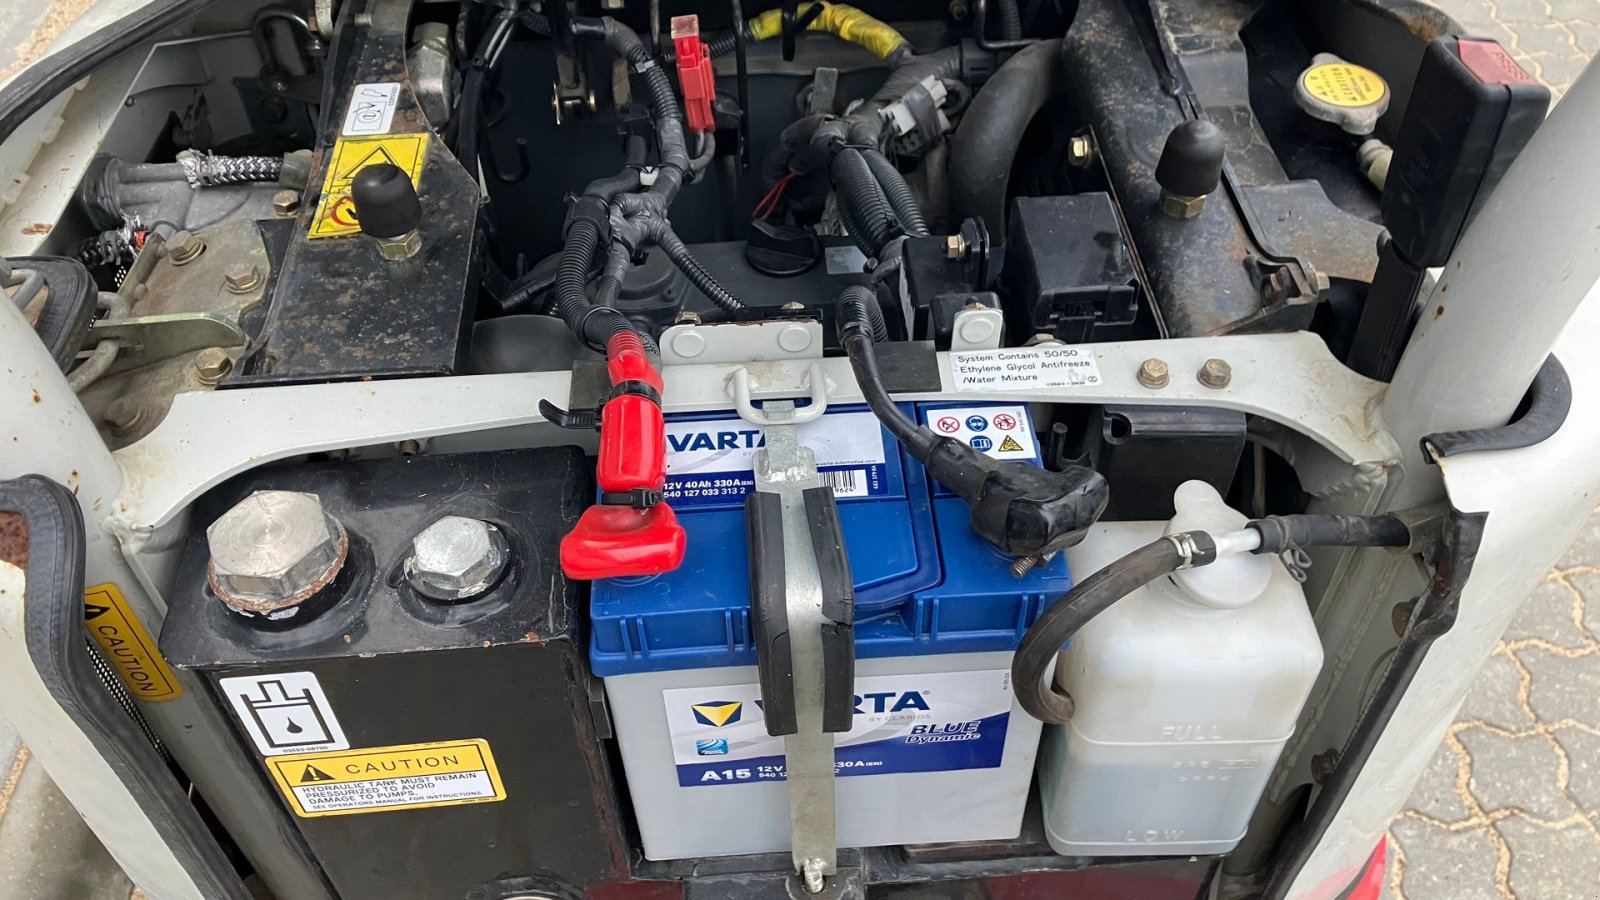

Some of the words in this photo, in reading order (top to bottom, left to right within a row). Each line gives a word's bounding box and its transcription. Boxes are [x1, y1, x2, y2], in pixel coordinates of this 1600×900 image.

[958, 355, 993, 364] System
[998, 353, 1040, 361] Contains
[1044, 350, 1078, 358] 50/50
[960, 364, 1002, 375] Ethylene
[1006, 362, 1036, 372] Glycol
[1041, 360, 1091, 369] Antifreeze
[963, 375, 996, 384] /Water
[1001, 374, 1038, 382] Mixture
[663, 482, 682, 490] 12V
[685, 480, 711, 488] 40Ah
[702, 488, 719, 496] 033
[721, 487, 738, 495] 313
[98, 625, 157, 691] CAUTION
[884, 714, 931, 722] CLARIOS
[910, 720, 982, 735] BLUE
[1161, 725, 1220, 740] FULL
[905, 731, 982, 744] Dynamic
[345, 755, 459, 774] CAUTION
[701, 769, 751, 781] A15
[302, 782, 365, 793] HYDRAULIC
[400, 776, 431, 785] MUST
[434, 772, 477, 781] REMAIN
[305, 787, 379, 799] PRESSURIZED
[402, 782, 435, 791] AVOID
[309, 795, 356, 805] DAMAGE
[360, 793, 374, 801] TO
[378, 791, 418, 799] PUMPS.
[328, 800, 374, 808] OPERATORS
[426, 791, 483, 800] INSTRUCTIONS.
[1125, 830, 1184, 841] LOW
